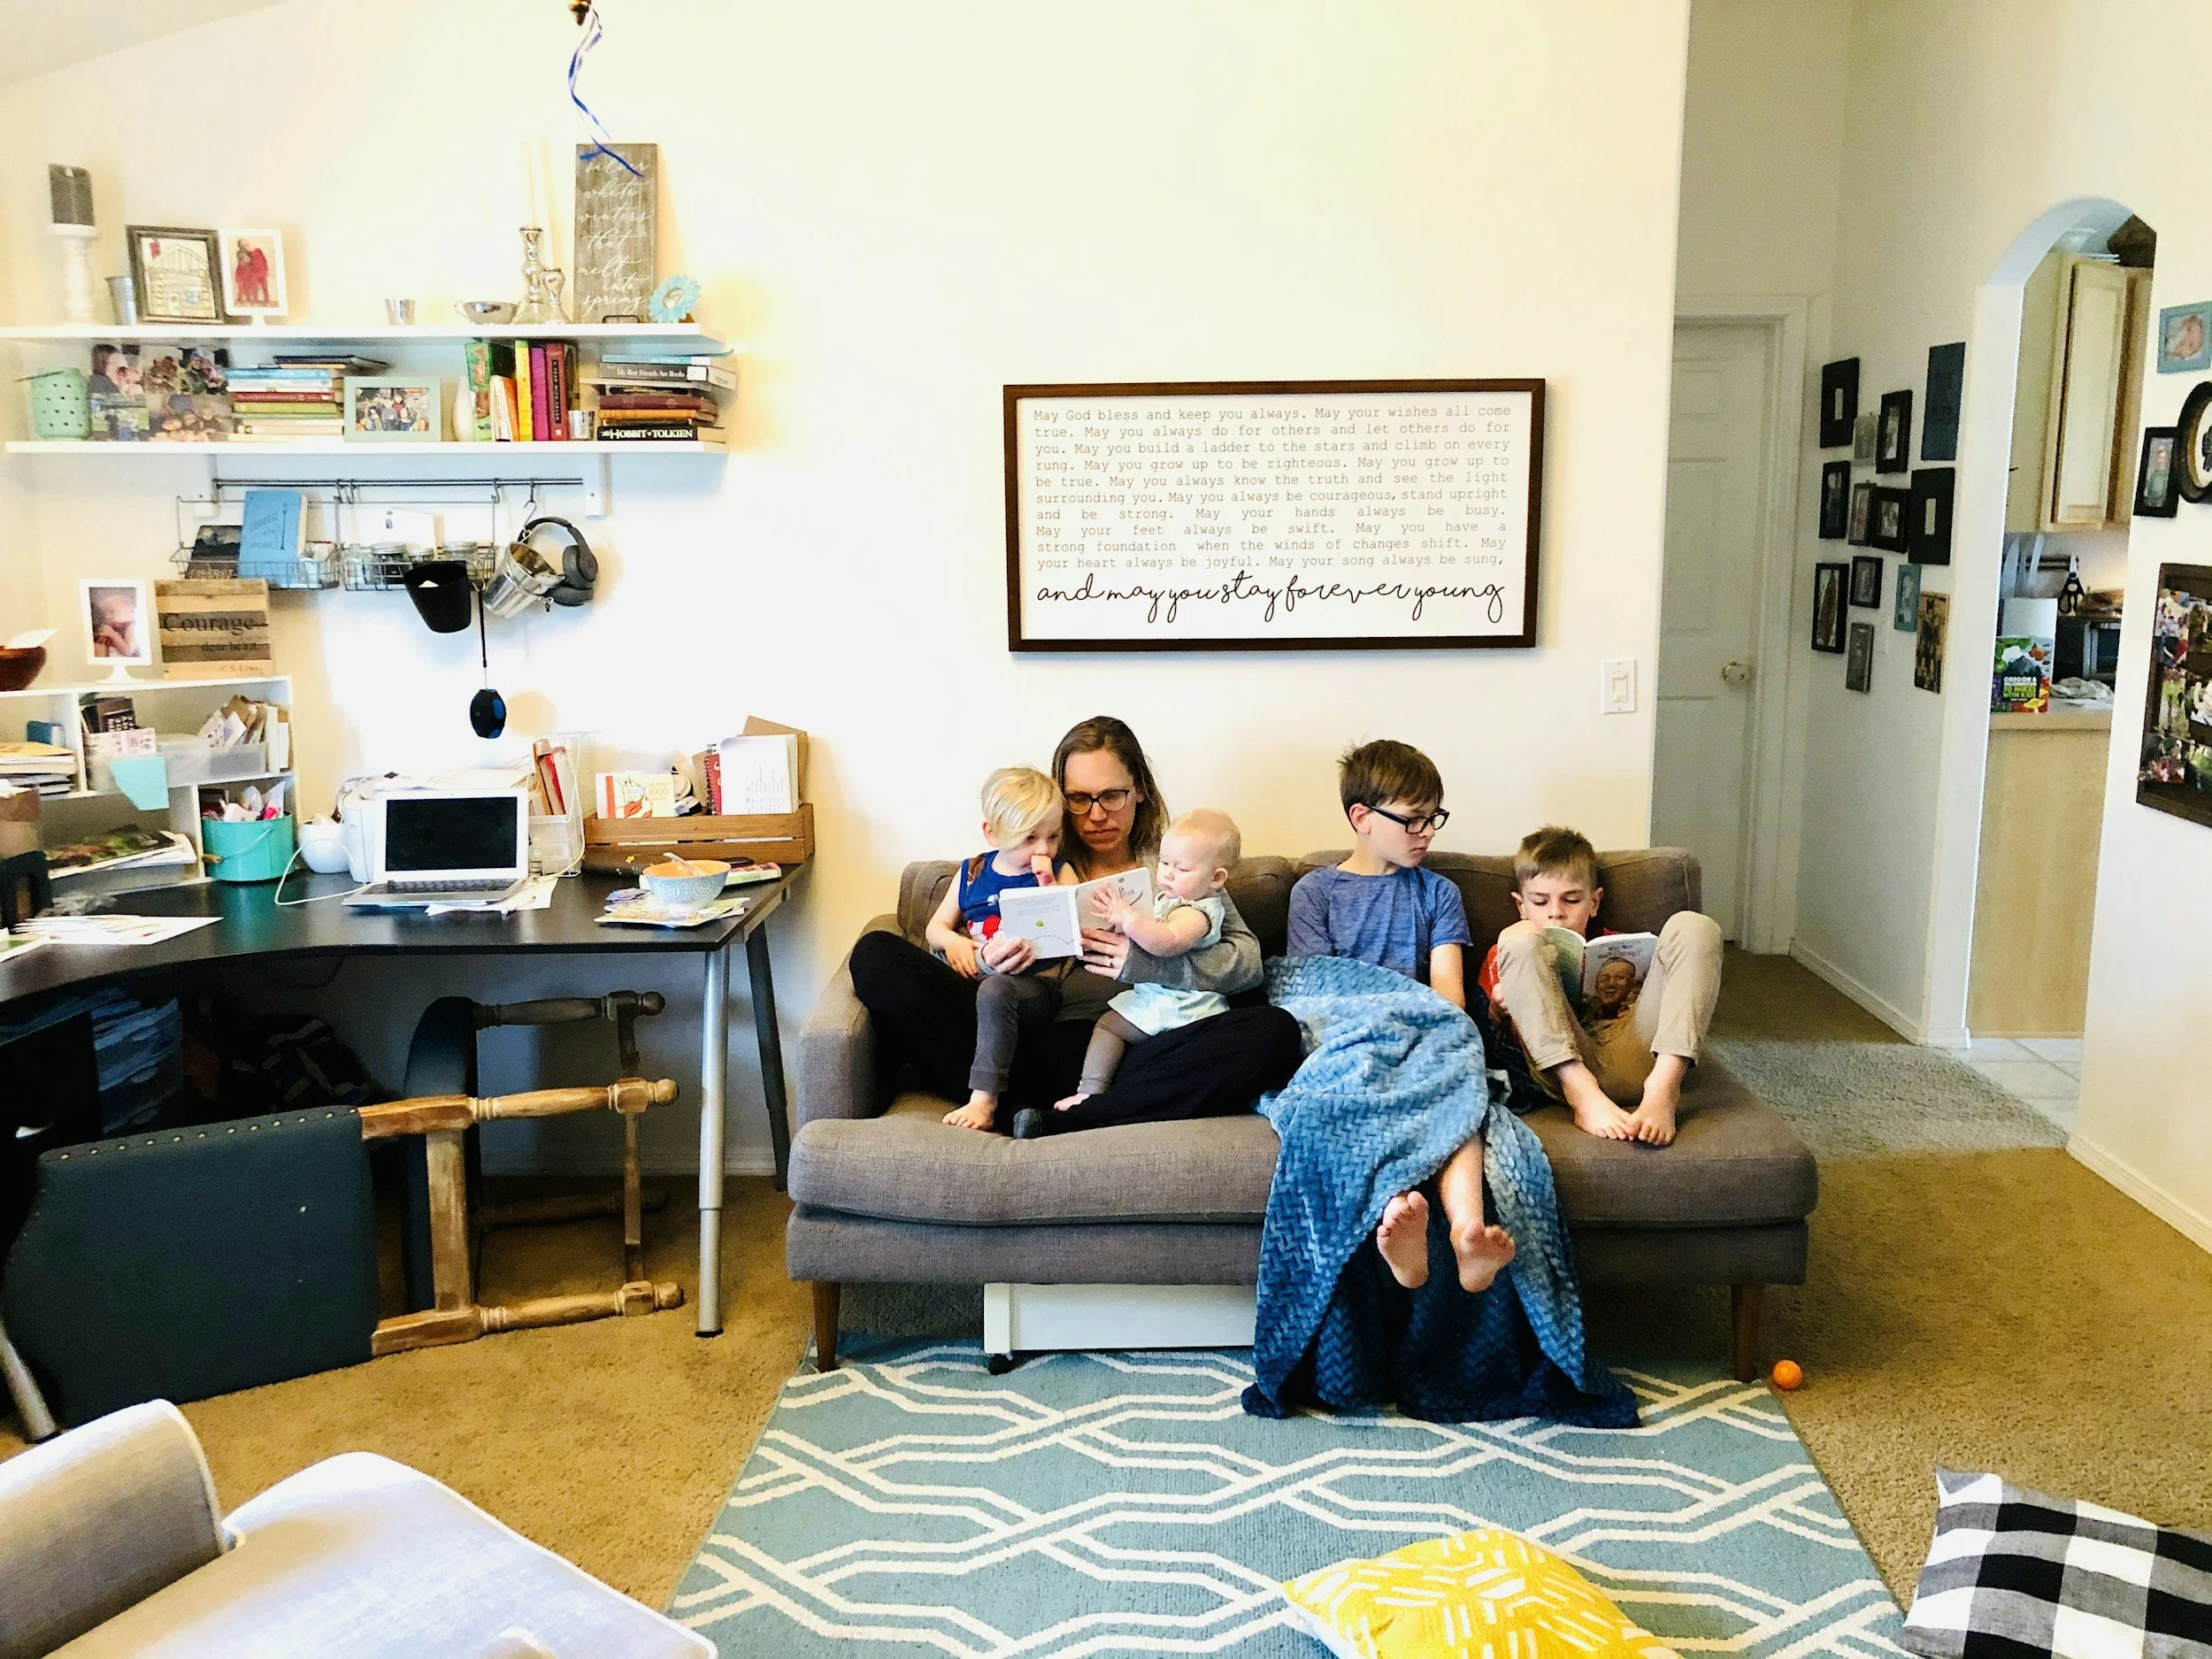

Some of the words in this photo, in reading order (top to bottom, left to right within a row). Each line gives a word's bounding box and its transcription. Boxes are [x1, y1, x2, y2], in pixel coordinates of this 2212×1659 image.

[581, 228, 646, 250] that
[577, 255, 641, 278] melt
[581, 295, 644, 319] spring
[1033, 410, 1059, 423] May
[1065, 410, 1091, 421] God
[1097, 409, 1139, 420] bless
[1146, 409, 1171, 420] and
[1178, 408, 1211, 422] keep
[1218, 411, 1243, 422] you
[1249, 407, 1306, 421] always.
[1315, 408, 1340, 421] May
[1348, 409, 1380, 420] your
[1387, 406, 1438, 418] wishes
[1445, 404, 1470, 416] all
[1478, 407, 1510, 416] come
[610, 428, 647, 440] HOBBIT
[651, 429, 693, 439] TOLKIEN
[1034, 427, 1073, 437] true.
[1084, 426, 1110, 440] May
[1118, 428, 1144, 439] you
[1152, 426, 1202, 440] always
[1211, 425, 1228, 436] do
[1238, 425, 1263, 436] for
[1271, 424, 1321, 435] others
[1330, 424, 1356, 435] and
[1365, 423, 1389, 434] let
[1399, 422, 1449, 434] others
[1458, 421, 1476, 433] do
[1486, 421, 1510, 433] for
[1034, 445, 1066, 457] you.
[1074, 443, 1100, 457] May
[1107, 444, 1132, 456] you
[1138, 442, 1180, 454] build
[1202, 441, 1251, 453] ladder
[1259, 442, 1275, 453] to
[1282, 441, 1307, 452] the
[1314, 442, 1356, 451] stars
[1362, 440, 1388, 450] and
[1394, 439, 1437, 450] climb
[1444, 441, 1461, 449] on
[1467, 441, 1510, 452] every
[1035, 462, 1074, 473] rung.
[1084, 460, 1110, 473] May
[1118, 461, 1142, 472] you
[1150, 461, 1184, 472] grow
[1191, 460, 1209, 472] up
[1217, 459, 1233, 469] to
[1241, 457, 1258, 469] be
[1266, 457, 1348, 471] righteous.
[1357, 457, 1383, 470] May
[1391, 458, 1417, 470] you
[1425, 457, 1458, 469] grow
[1467, 457, 1484, 469] up
[1493, 457, 1509, 466] to
[1033, 476, 1052, 487] be
[1061, 477, 1100, 487] true.
[1109, 475, 1134, 489] May
[1143, 478, 1167, 489] you
[1175, 474, 1225, 488] always
[1233, 474, 1267, 486] know
[1274, 473, 1299, 485] the
[1308, 473, 1349, 485] truth
[1357, 472, 1383, 484] and
[1394, 475, 1418, 484] see
[1429, 472, 1455, 482] the
[1465, 471, 1508, 485] light
[1036, 492, 1125, 506] surrounding
[1132, 494, 1163, 505] you.
[1168, 492, 1194, 505] May
[1199, 493, 1224, 504] you
[1230, 491, 1279, 504] always
[1286, 490, 1303, 501] be
[1309, 491, 1396, 503] courageous,
[1401, 489, 1443, 500] stand
[1449, 488, 1508, 502] upright
[1036, 509, 1061, 519] and
[1080, 509, 1098, 519] be
[1118, 509, 1173, 521] strong.
[1195, 506, 1221, 521] May
[1241, 510, 1274, 521] your
[1294, 506, 1335, 518] hands
[1356, 505, 1406, 519] always
[1426, 504, 1444, 515] be
[1465, 504, 1505, 518] busy.
[1036, 526, 1062, 538] May
[1080, 527, 1112, 539] your
[1133, 524, 1164, 535] feet
[1183, 523, 1232, 537] always
[1251, 523, 1268, 534] be
[1287, 522, 1334, 534] swift.
[1356, 522, 1381, 535] May
[1401, 524, 1425, 535] you
[1445, 520, 1479, 532] have
[1037, 541, 1086, 555] strong
[1096, 540, 1177, 551] foundation
[1196, 540, 1229, 550] when
[1240, 540, 1264, 550] the
[1274, 539, 1315, 549] winds
[1325, 539, 1342, 549] of
[1353, 538, 1410, 551] changes
[1420, 537, 1469, 548] shift.
[1480, 537, 1507, 551] May
[1037, 559, 1069, 571] your
[1077, 557, 1118, 568] heart
[1125, 557, 1173, 571] always
[1180, 557, 1197, 567] be
[1205, 556, 1260, 570] joyful.
[1268, 556, 1294, 569] May
[1302, 557, 1334, 568] your
[1341, 557, 1375, 567] song
[1382, 554, 1432, 568] always
[1439, 553, 1456, 565] be
[1463, 556, 1503, 566] sung,
[1037, 572, 1106, 602] and
[1106, 586, 1165, 624] may
[1166, 588, 1220, 624] you
[1220, 570, 1284, 623] stay
[1286, 574, 1411, 612] forever
[1412, 583, 1506, 624] young
